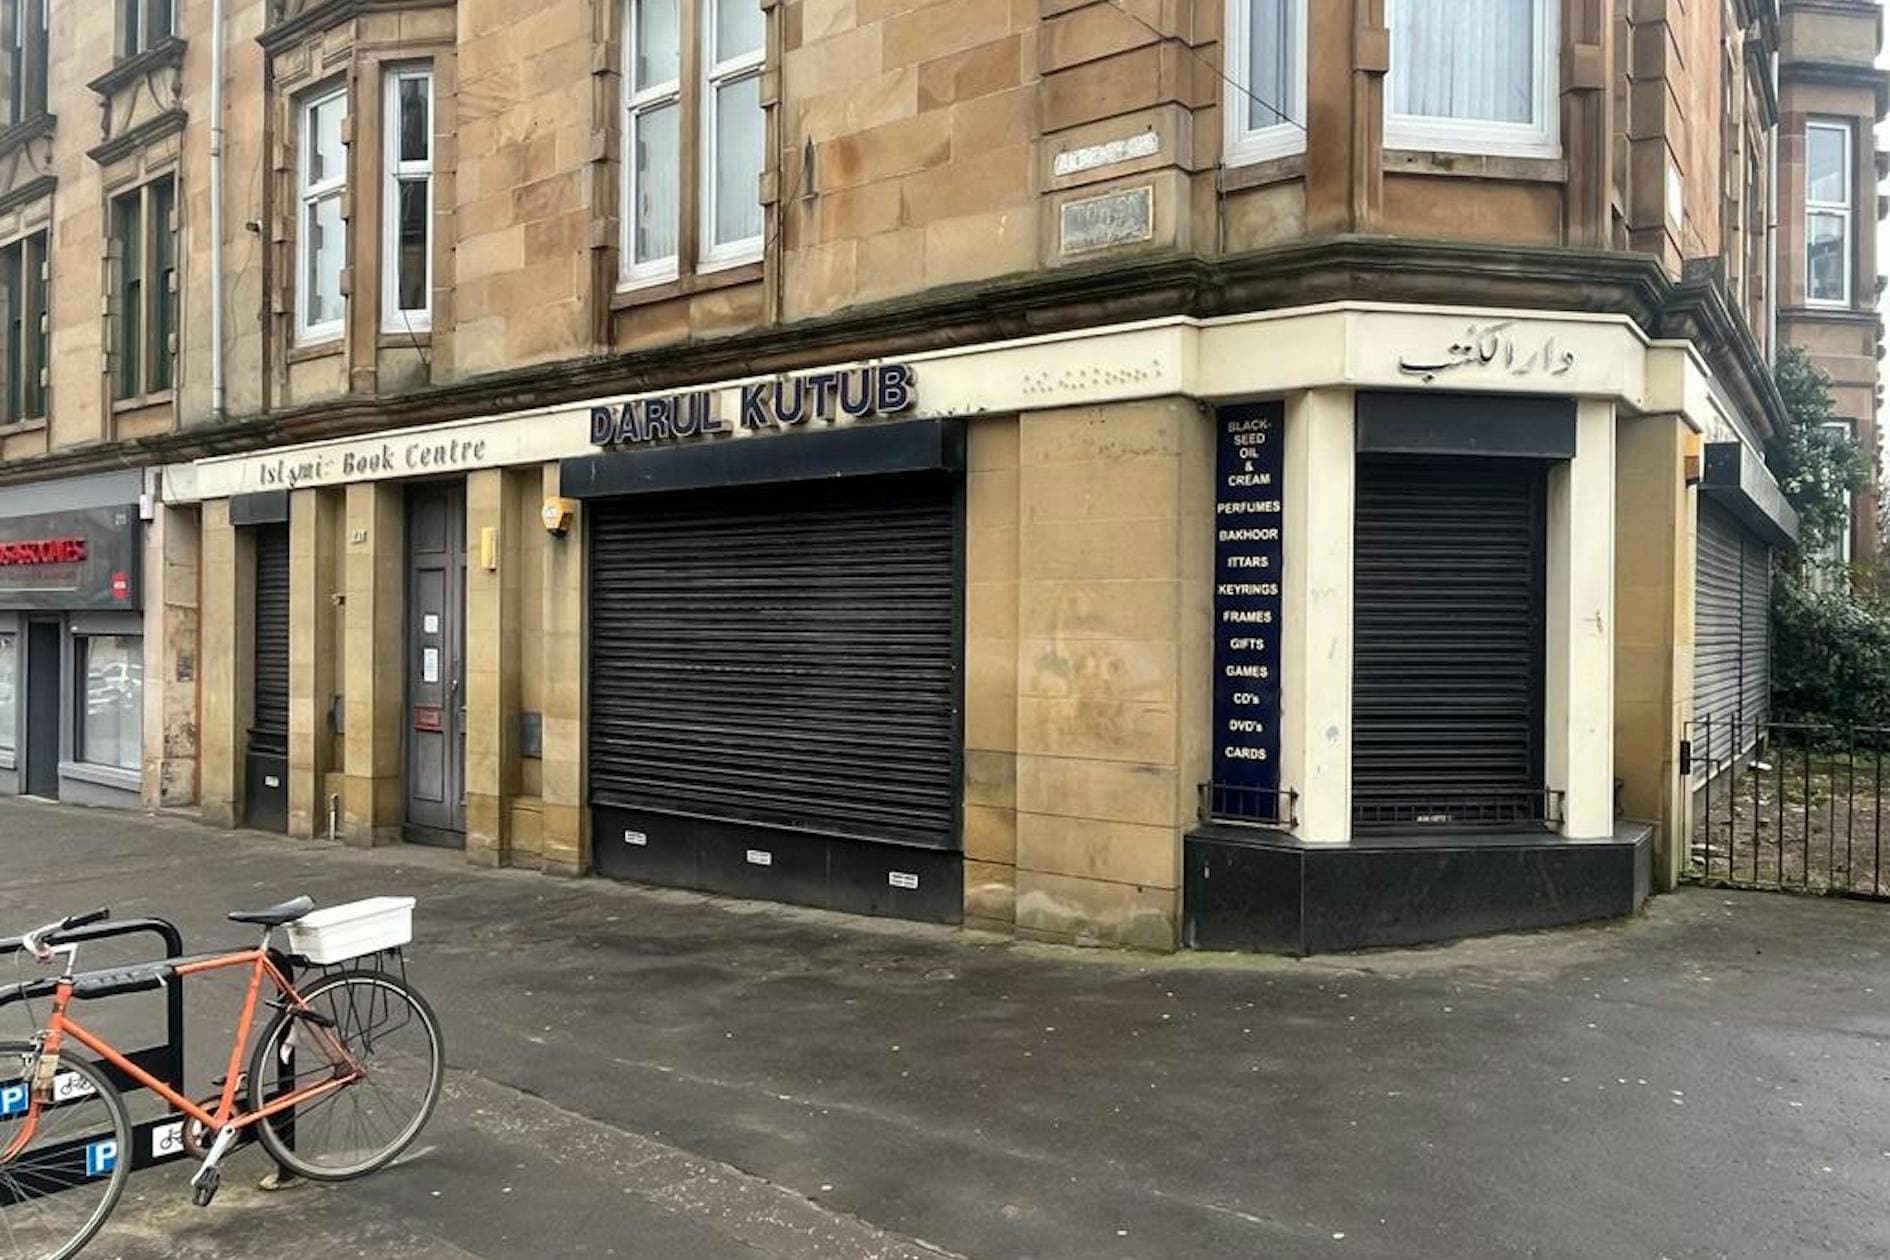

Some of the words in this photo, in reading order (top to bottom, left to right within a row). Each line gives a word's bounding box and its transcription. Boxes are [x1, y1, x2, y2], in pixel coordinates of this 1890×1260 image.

[591, 390, 730, 448] DARUL
[741, 364, 917, 430] KUTUB
[1228, 419, 1269, 432] BLACK
[1234, 433, 1265, 445] SEED
[343, 444, 393, 476] Book
[406, 439, 486, 472] Centre
[1240, 448, 1259, 458] OIL
[1245, 461, 1254, 472] &
[1228, 473, 1271, 486] CREAM
[1217, 500, 1280, 514] PERFUMES
[1219, 528, 1278, 541] BAKHOOR
[1228, 556, 1269, 568] ITTARS
[1218, 583, 1278, 595] KEYRINGS
[1223, 610, 1272, 623] FRAMES
[1230, 638, 1264, 650] GIFTS
[1226, 665, 1268, 678] GAMES
[1229, 719, 1263, 732] DVD's
[1225, 746, 1267, 760] CARDS
[2, 1086, 23, 1114] P
[96, 1141, 118, 1171] P
